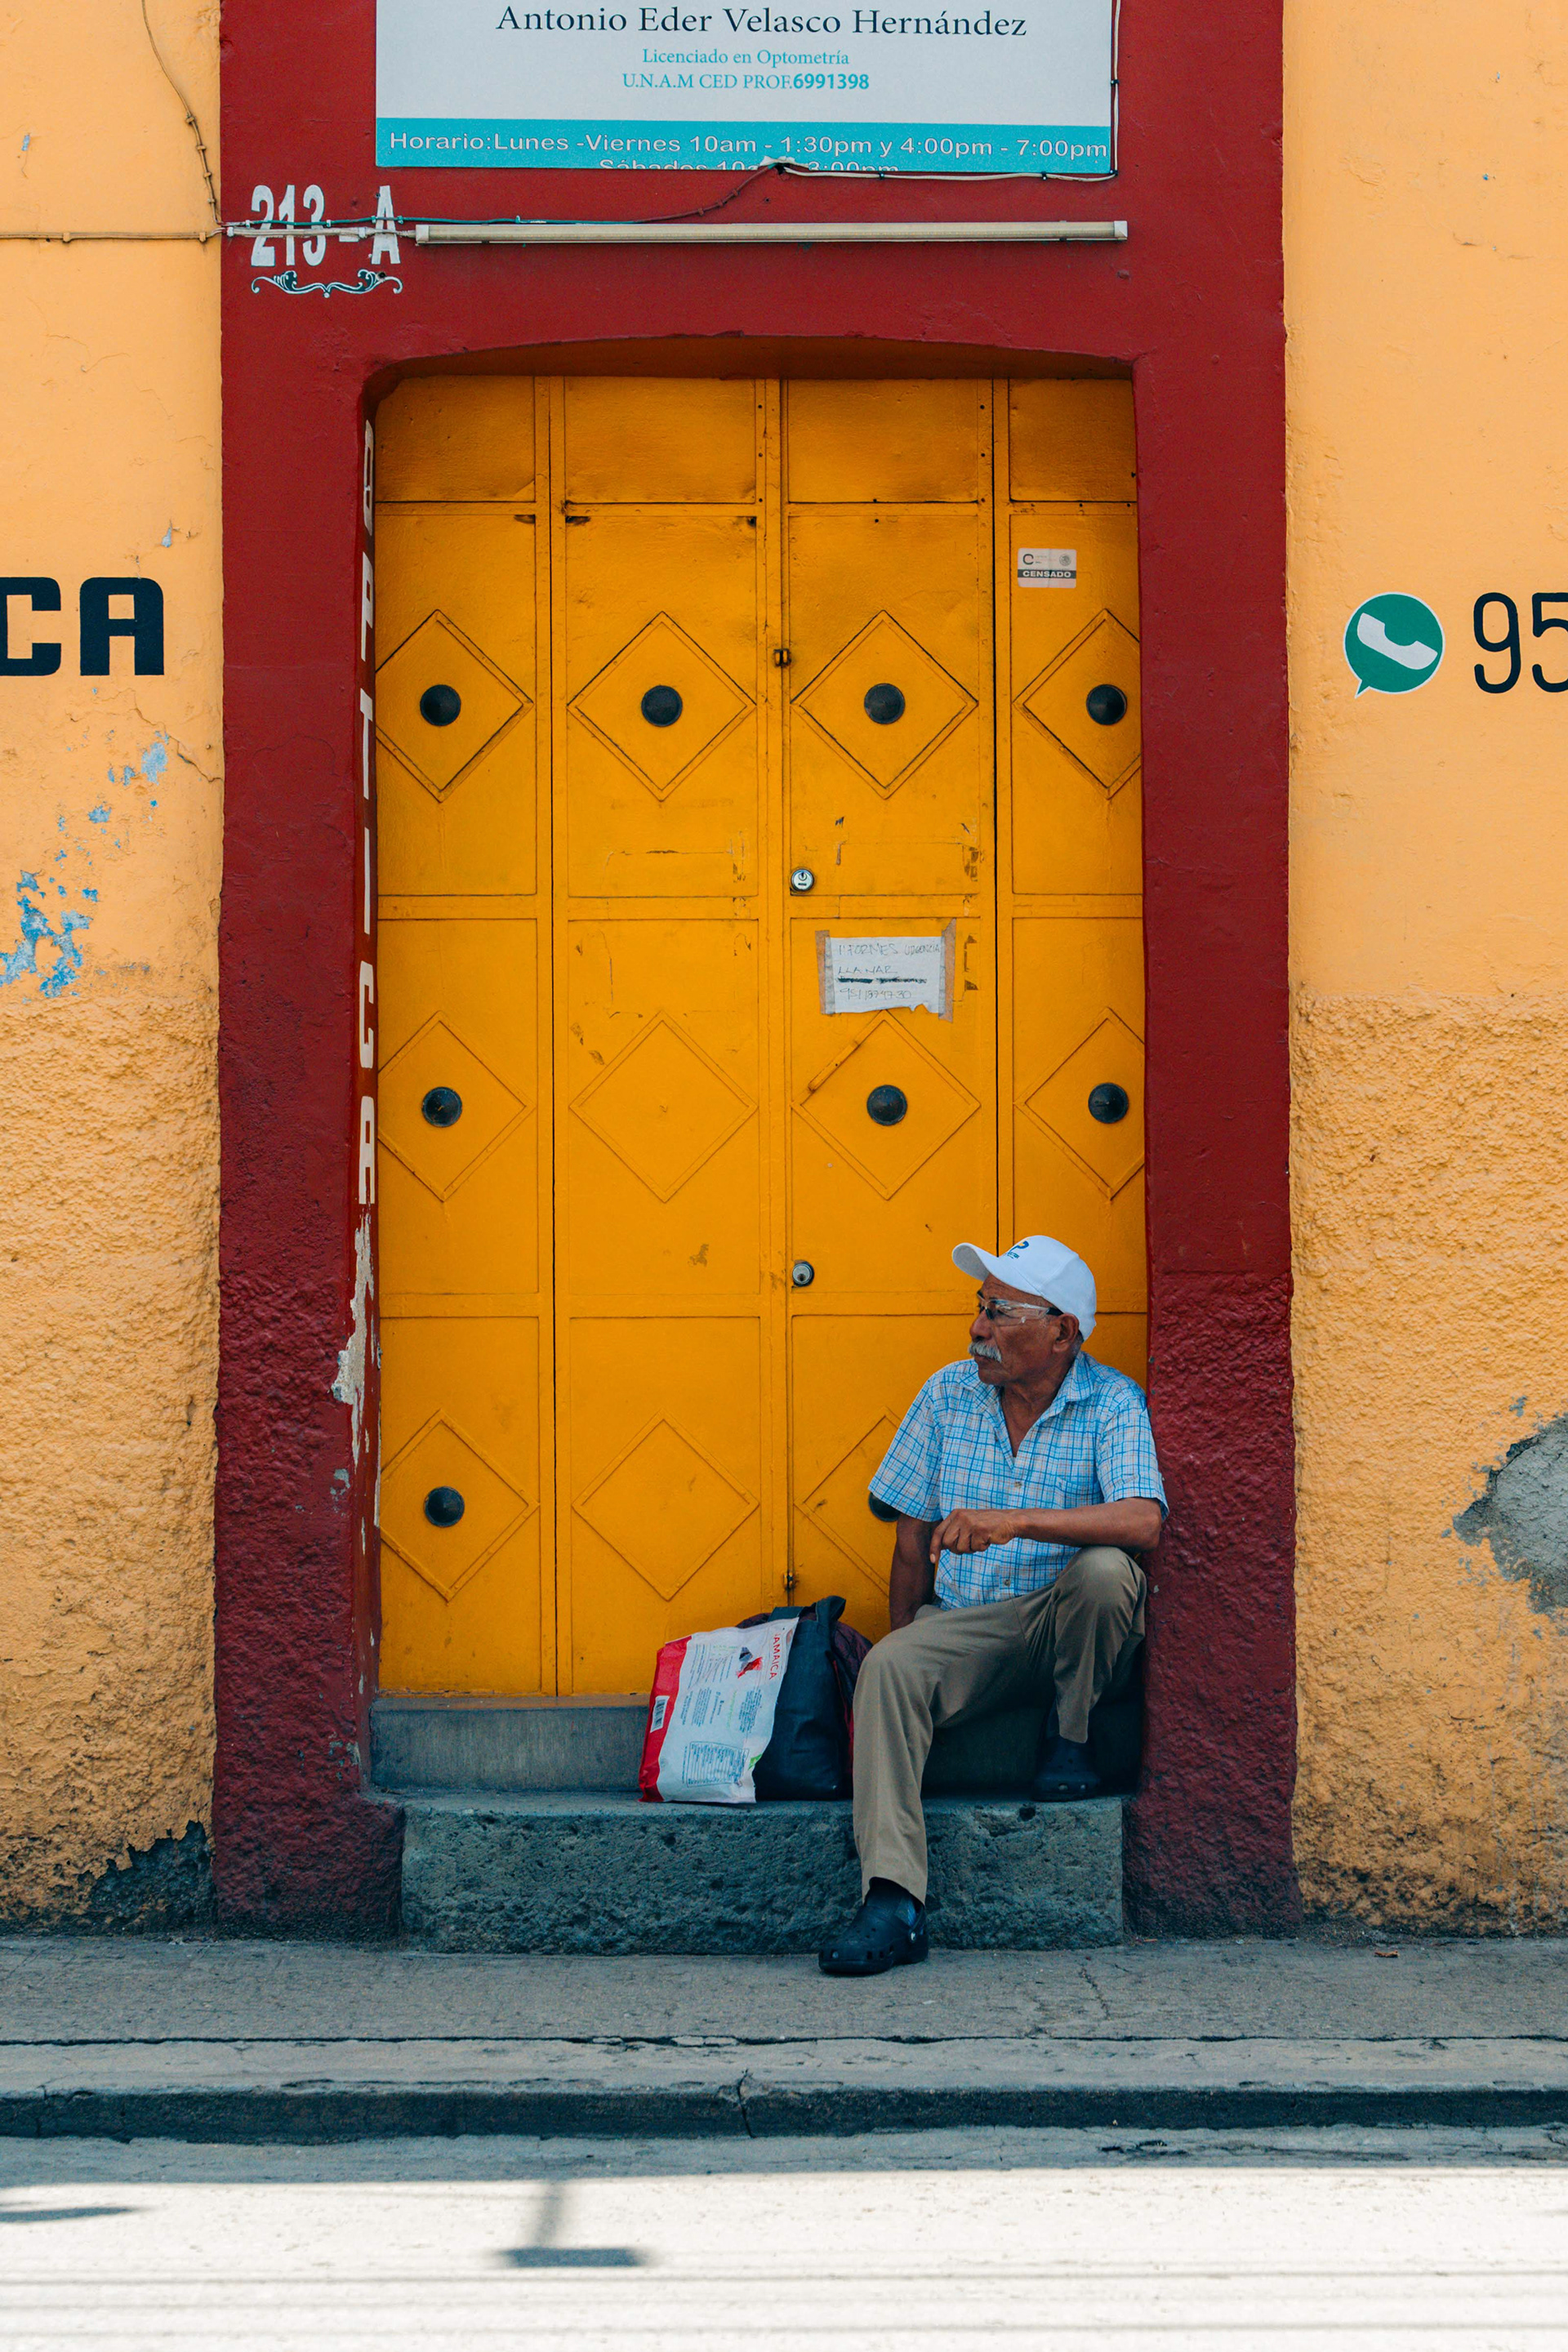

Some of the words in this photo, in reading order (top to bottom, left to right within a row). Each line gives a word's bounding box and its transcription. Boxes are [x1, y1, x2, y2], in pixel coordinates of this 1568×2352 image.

[495, 7, 628, 32] Antonio
[639, 7, 714, 33] Eder
[724, 7, 842, 33] Velasco
[852, 9, 1028, 37] Hernández
[642, 49, 729, 65] Licenciado
[733, 54, 753, 65] en
[757, 50, 850, 68] Optometría
[622, 73, 694, 90] U.N.A.M
[698, 74, 739, 90] CED
[690, 136, 758, 154] 10am
[780, 136, 873, 158] 1:30pm
[880, 141, 894, 158] y
[899, 137, 994, 160] 4:00pm
[1017, 140, 1108, 162] 7:00pm
[1022, 570, 1071, 578] CENSADO
[0, 577, 165, 676] CA
[1472, 591, 1568, 694] 95
[768, 1633, 782, 1681] AMAICA
